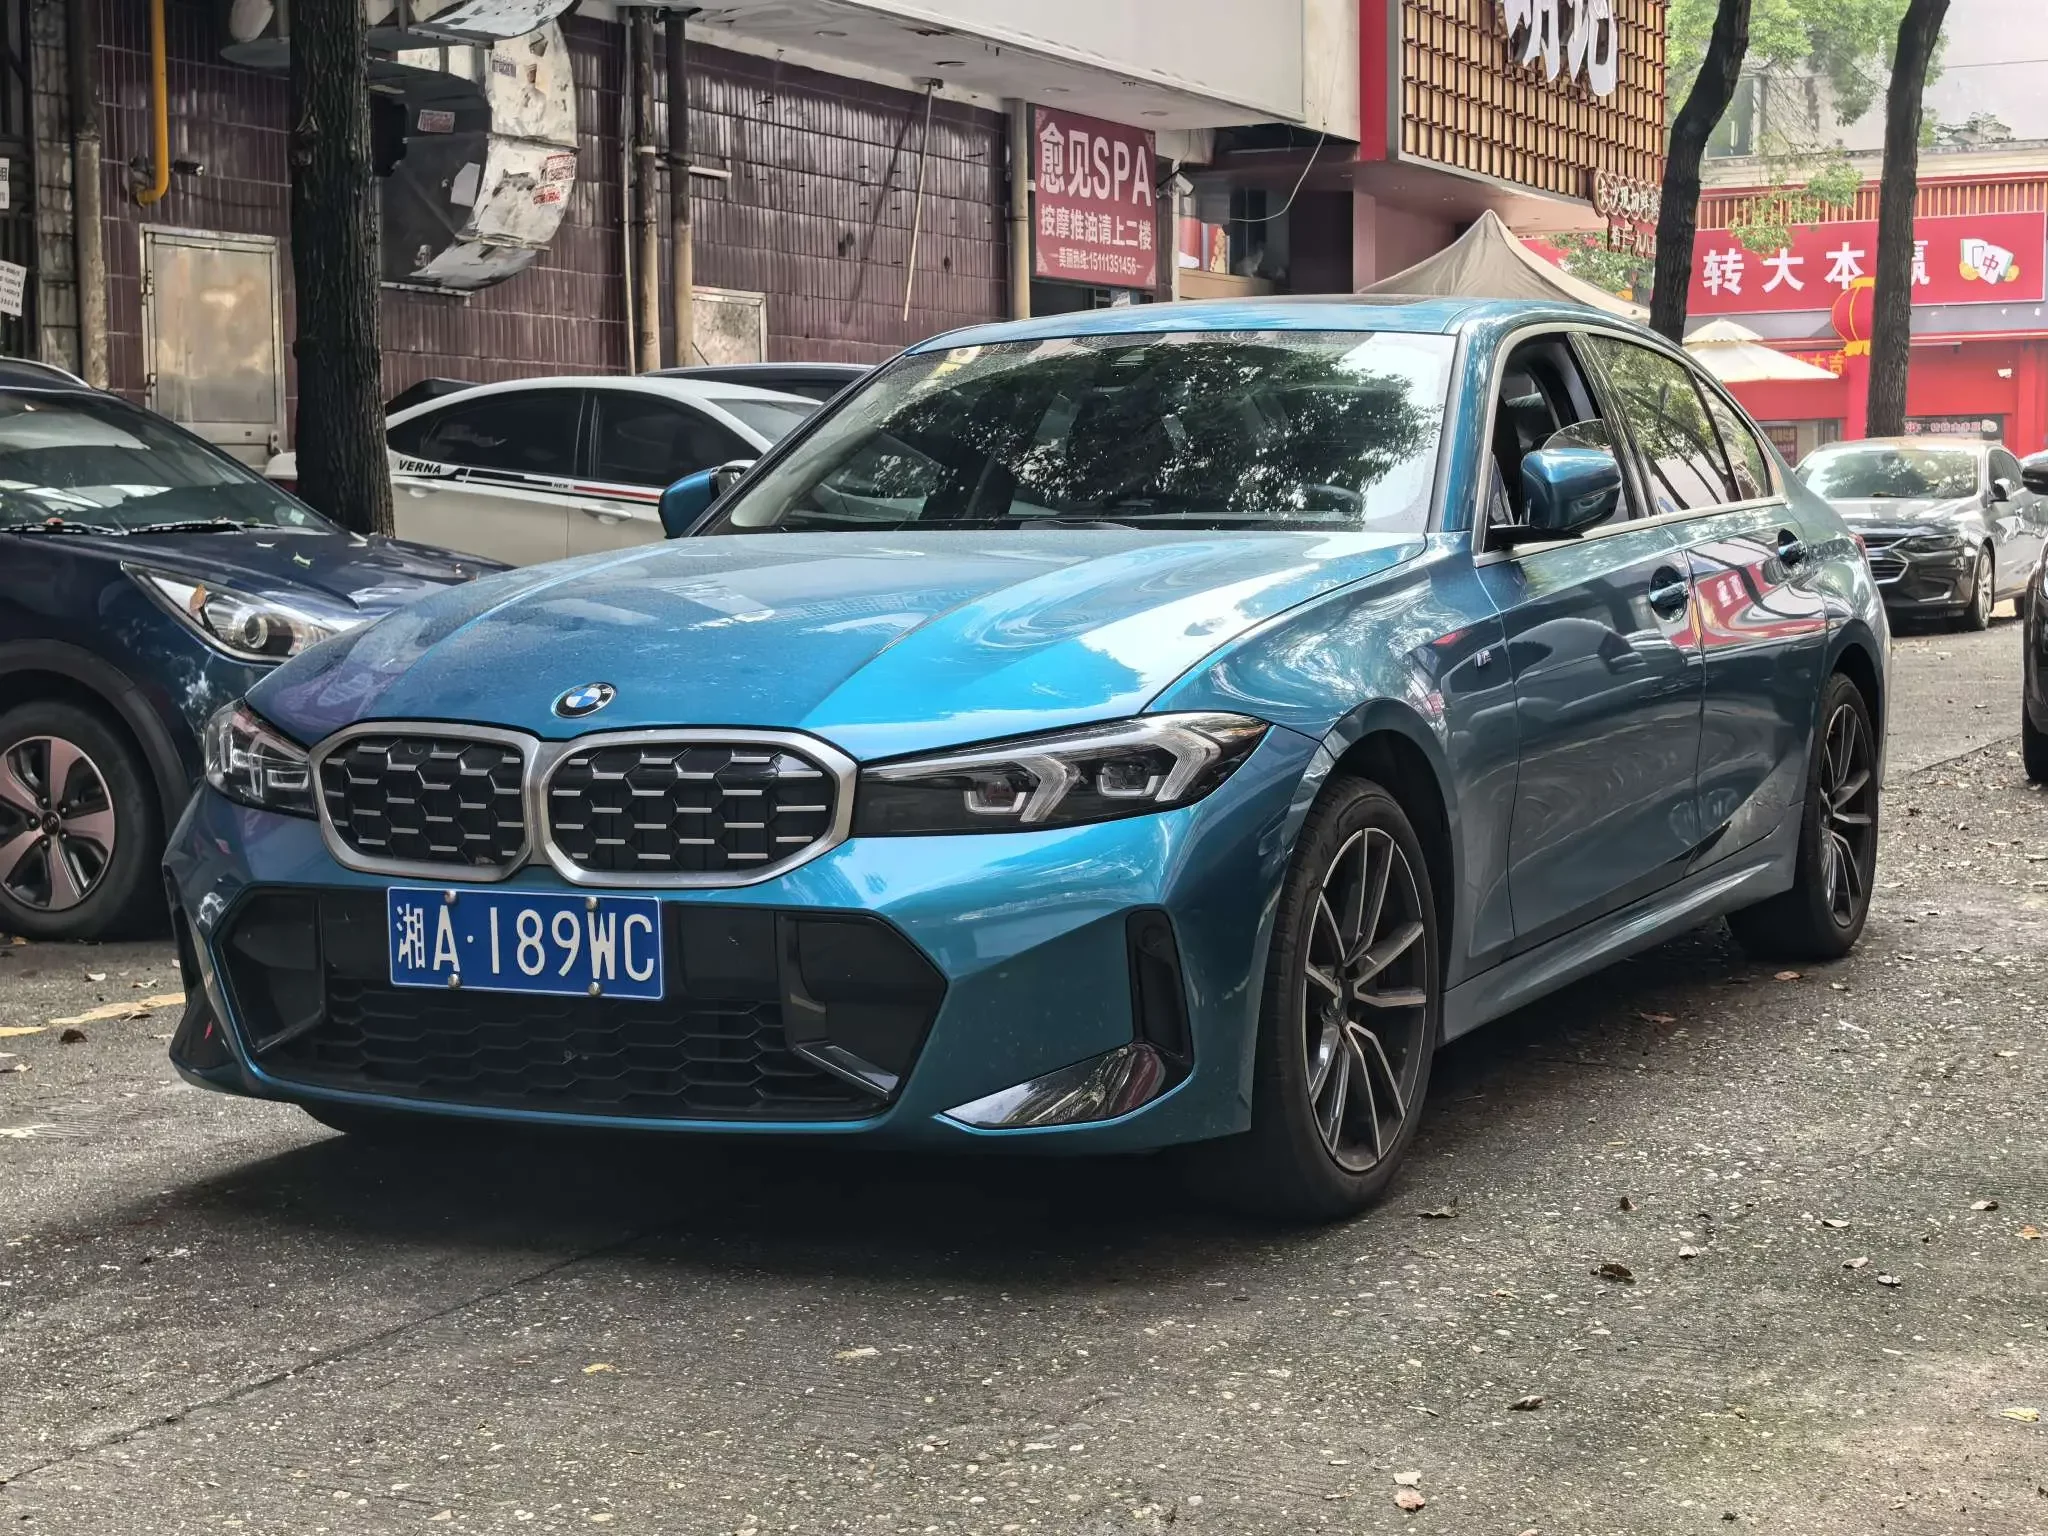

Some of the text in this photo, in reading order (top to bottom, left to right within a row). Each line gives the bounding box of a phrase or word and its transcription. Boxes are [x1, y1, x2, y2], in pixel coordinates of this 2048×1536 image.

[1040, 122, 1151, 207] 愈见SPA
[1041, 203, 1151, 250] 按摩推油请上二楼
[399, 460, 442, 474] VERNA
